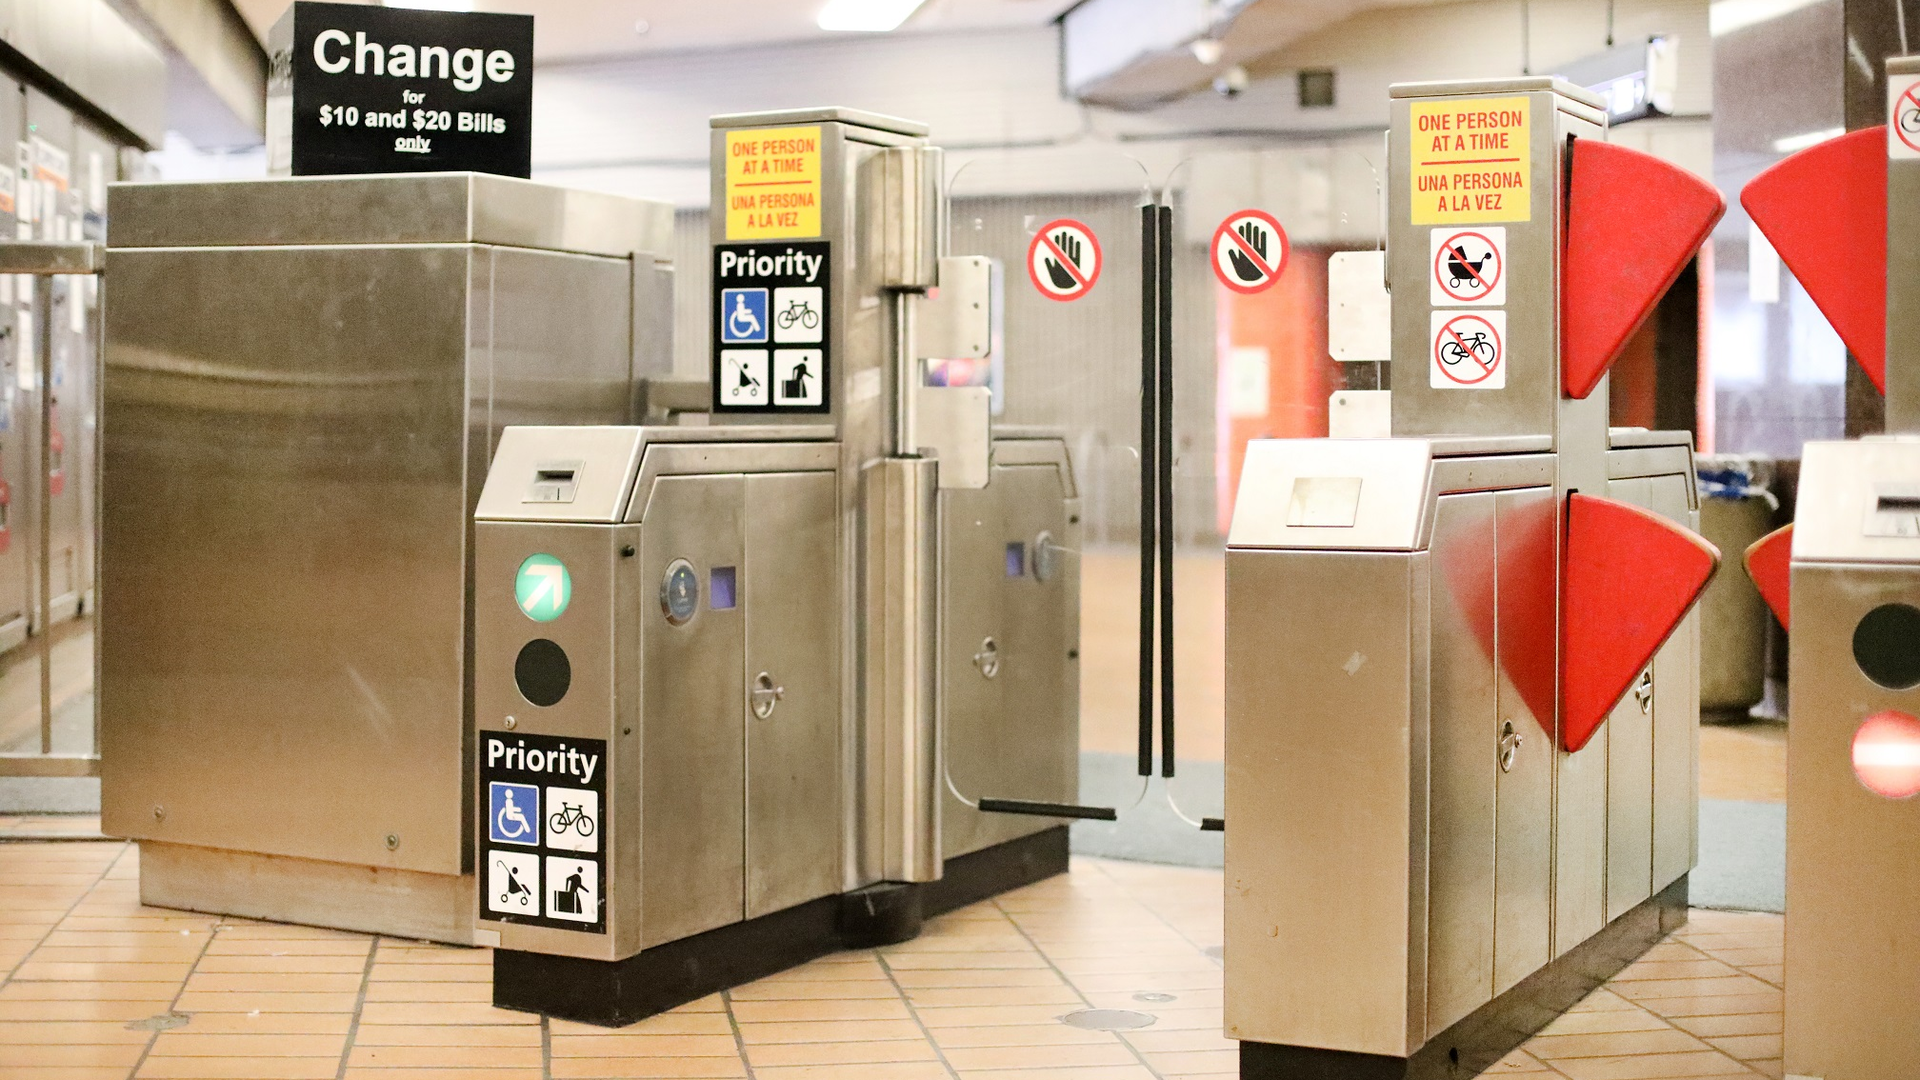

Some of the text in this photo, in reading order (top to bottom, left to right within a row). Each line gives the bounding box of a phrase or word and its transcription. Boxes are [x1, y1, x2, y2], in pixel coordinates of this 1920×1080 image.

[313, 29, 515, 92] Change
[403, 89, 426, 104] for
[319, 104, 506, 134] $10 and $20 Bills
[1419, 111, 1522, 131] ONE PERSON
[394, 135, 431, 153] only
[732, 139, 815, 157] ONE PERSON
[1432, 132, 1509, 152] AT A TIME
[743, 158, 804, 175] AT A TIME
[1418, 171, 1522, 192] UNA PERSONA
[732, 192, 814, 210] UNA PERSONA
[1437, 193, 1502, 212] A LA VEZ
[747, 212, 799, 228] A LA VEZ
[720, 249, 822, 283] Priority
[488, 739, 598, 784] Priority
